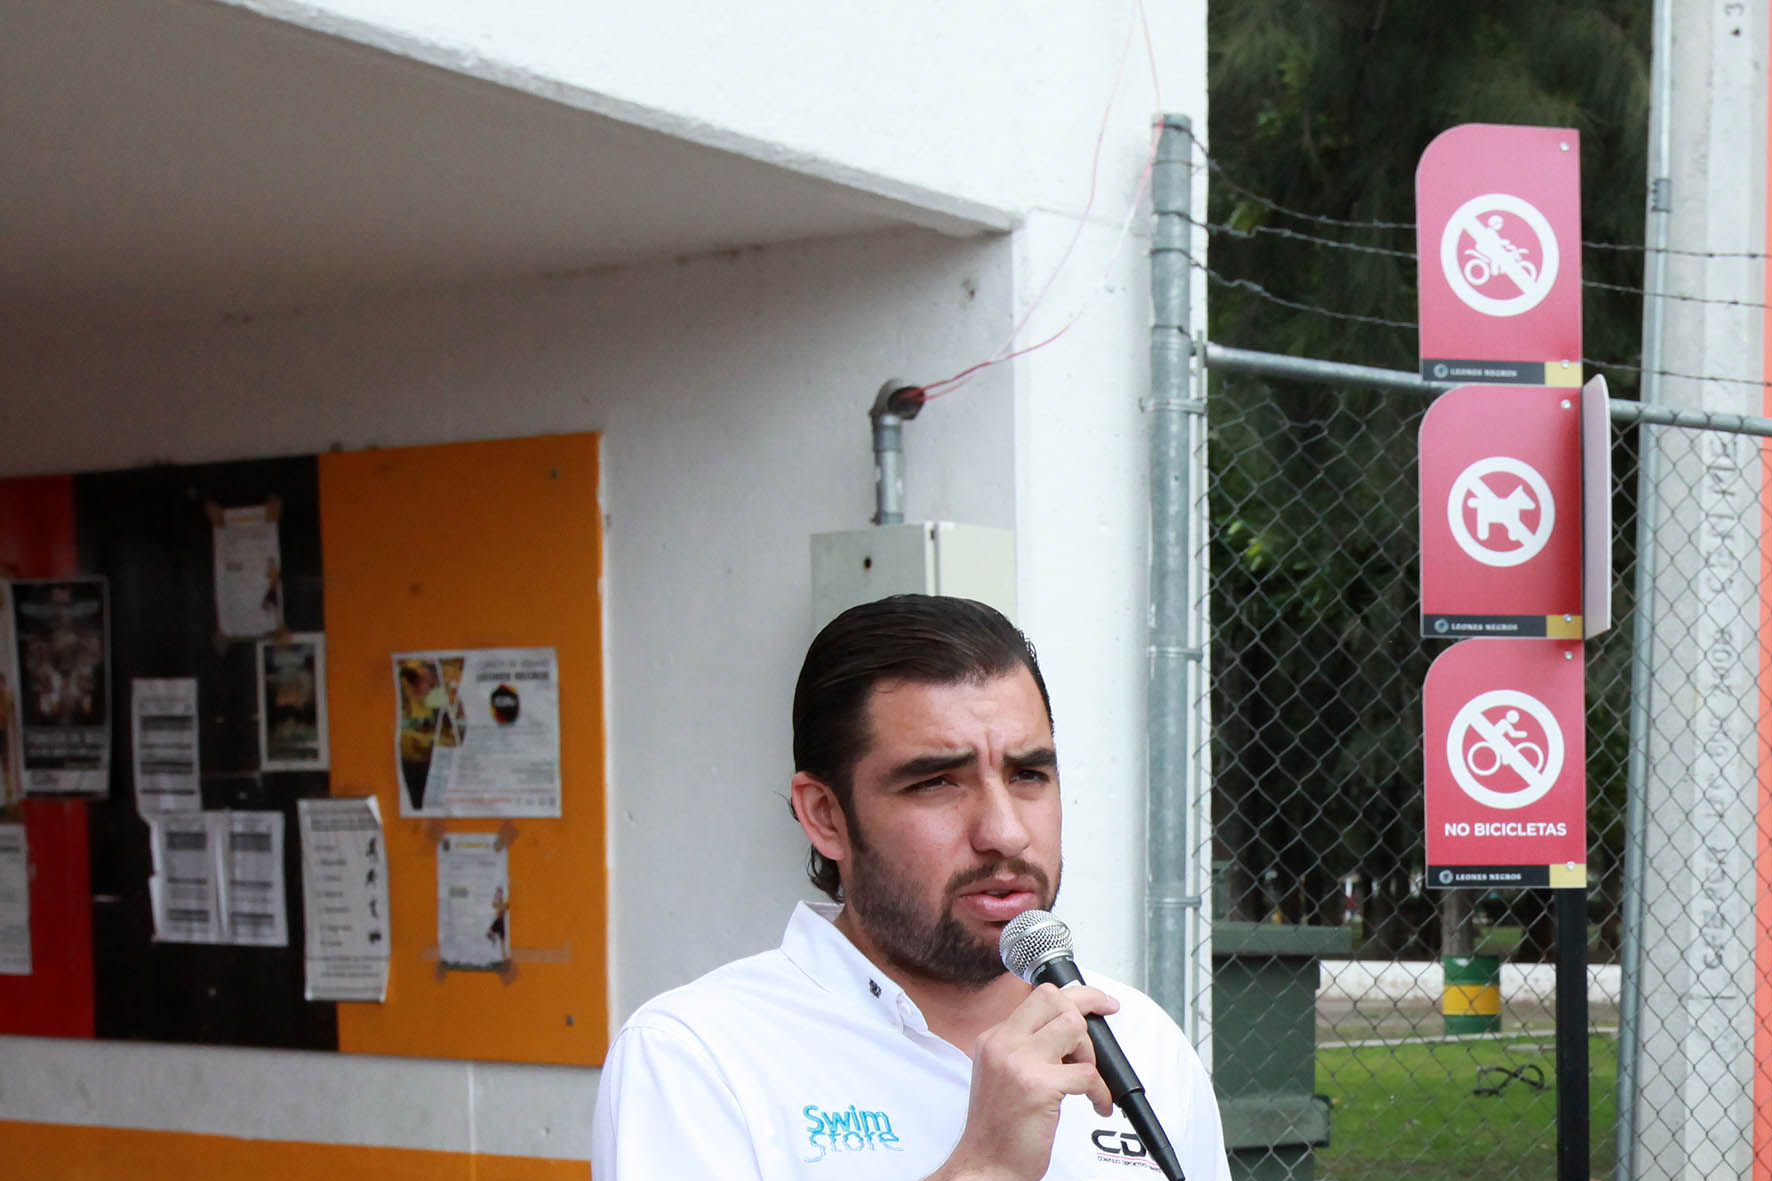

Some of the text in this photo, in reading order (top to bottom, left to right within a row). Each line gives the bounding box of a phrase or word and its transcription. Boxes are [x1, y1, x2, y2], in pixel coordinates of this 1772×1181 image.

[1444, 822, 1567, 837] NO BICICLETAS
[1455, 872, 1487, 881] LEONES
[803, 1104, 892, 1132] Swim
[804, 1130, 904, 1163] Store
[1091, 1129, 1147, 1157] CD
